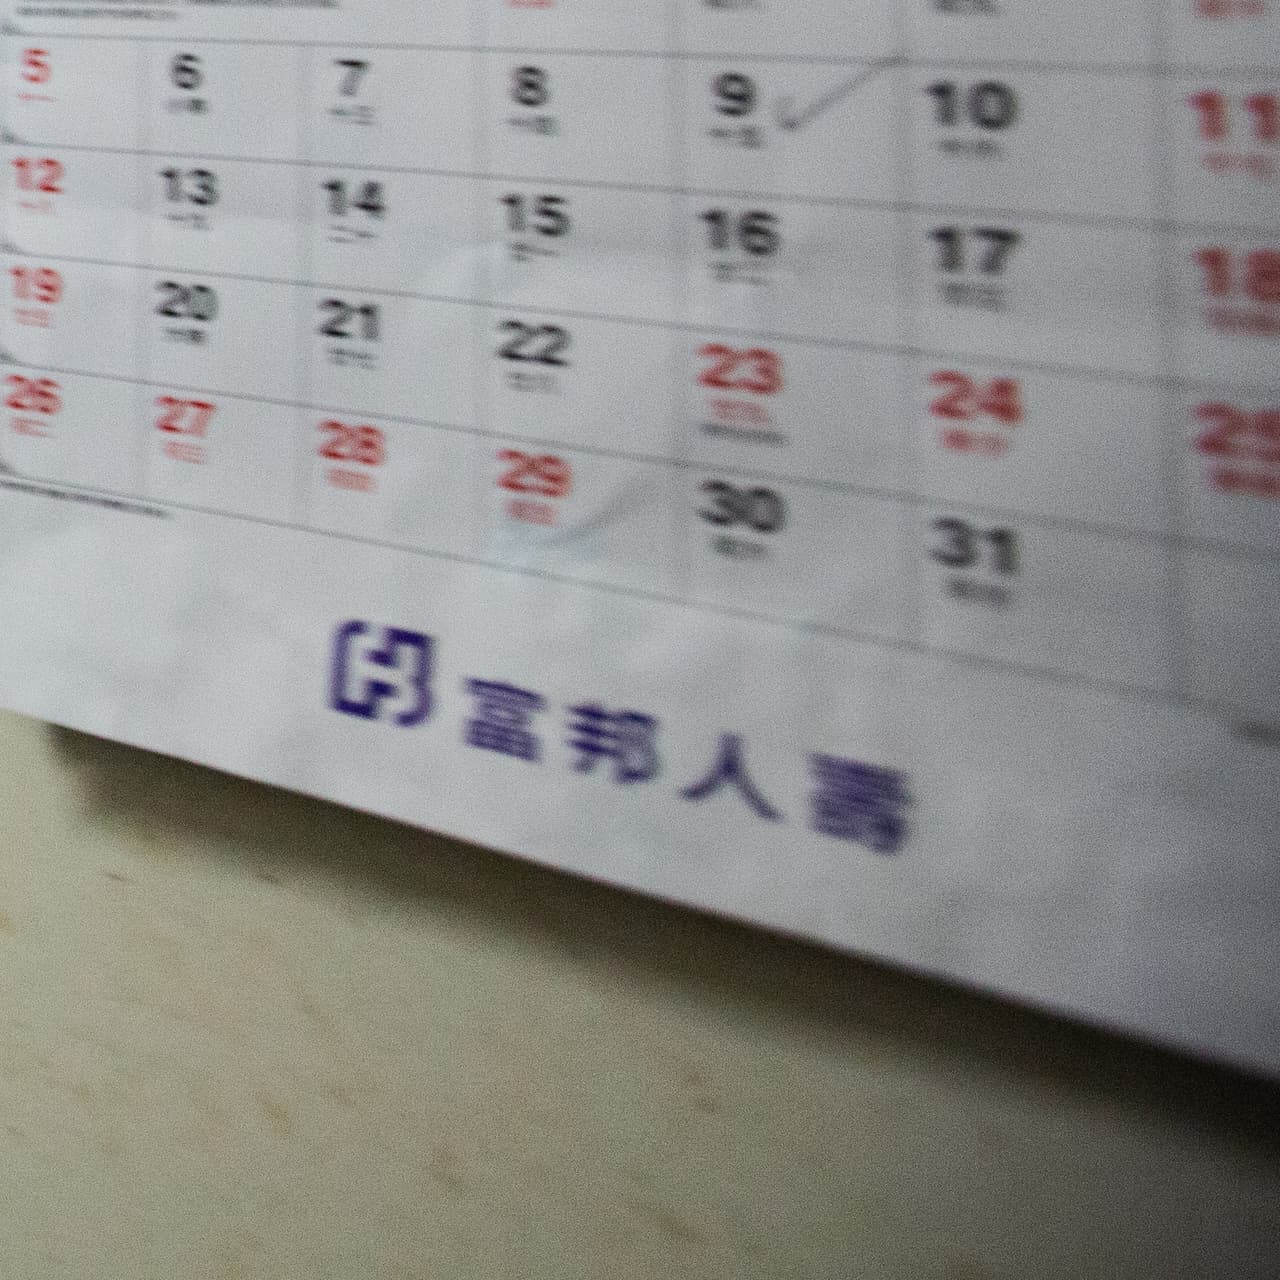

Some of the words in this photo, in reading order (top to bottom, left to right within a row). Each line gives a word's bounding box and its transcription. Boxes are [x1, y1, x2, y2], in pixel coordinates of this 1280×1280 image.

[21, 47, 52, 84] 5
[171, 52, 202, 92] 6
[334, 58, 370, 98] 7
[512, 64, 549, 109] 8
[713, 71, 757, 119] 9
[925, 79, 1019, 133] 10
[1187, 90, 1280, 143] 11
[12, 157, 63, 195] 12
[159, 167, 219, 208] 13
[322, 179, 386, 218] 14
[500, 193, 571, 239] 15
[699, 208, 780, 259] 16
[929, 225, 1022, 275] 17
[10, 266, 63, 305] 19
[155, 279, 217, 323] 20
[319, 297, 379, 340] 21
[497, 319, 569, 369] 22
[698, 343, 784, 397] 23
[929, 370, 1024, 426] 24
[4, 373, 59, 416] 26
[155, 394, 216, 435] 27
[318, 419, 383, 467] 28
[497, 448, 572, 499] 29
[699, 479, 786, 535] 30
[931, 516, 1021, 578] 31
[460, 677, 914, 856] 富邦人壽
